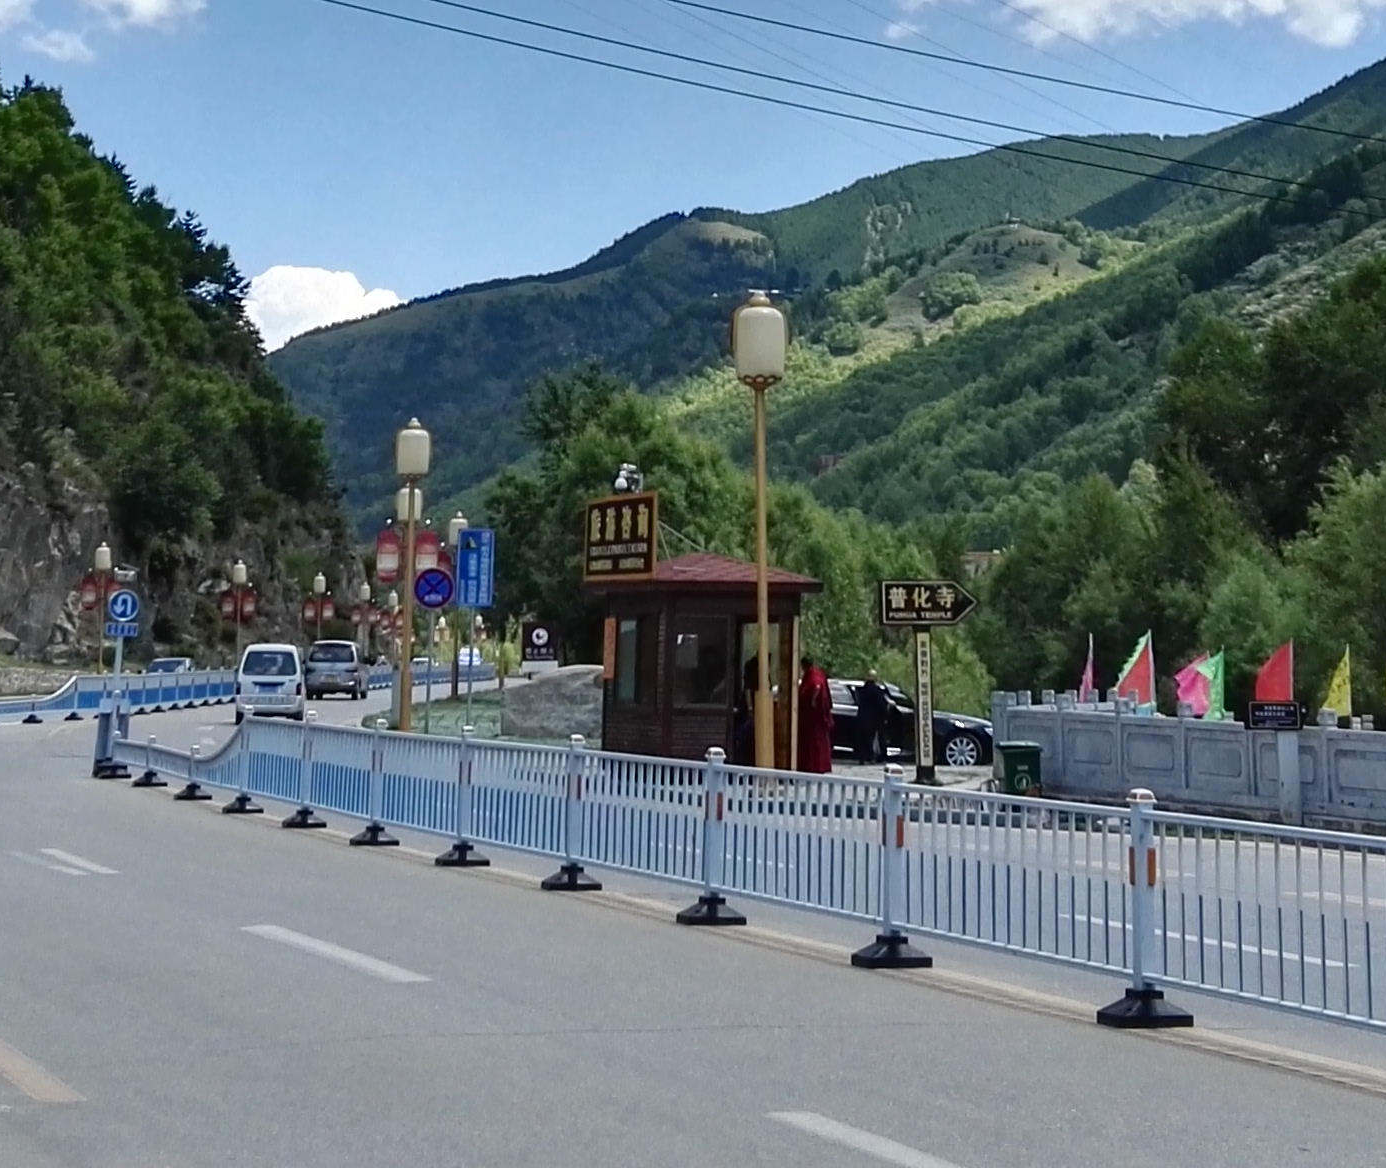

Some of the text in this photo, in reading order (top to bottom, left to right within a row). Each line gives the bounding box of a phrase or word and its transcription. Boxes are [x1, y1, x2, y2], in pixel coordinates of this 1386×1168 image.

[888, 586, 955, 609] 普化寺
[920, 611, 953, 619] TEMPLE
